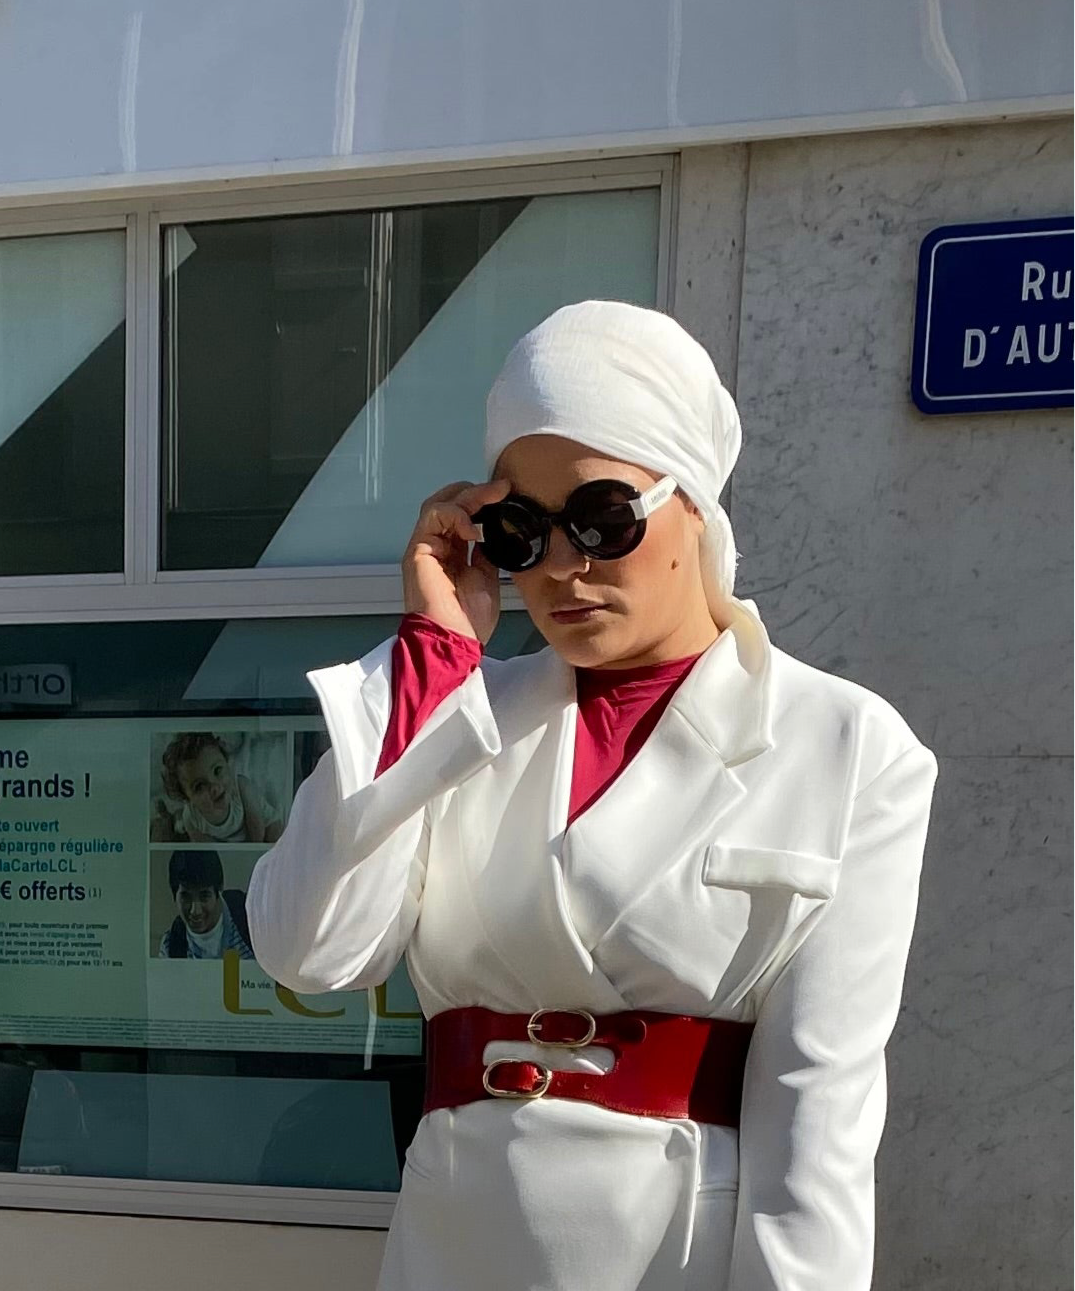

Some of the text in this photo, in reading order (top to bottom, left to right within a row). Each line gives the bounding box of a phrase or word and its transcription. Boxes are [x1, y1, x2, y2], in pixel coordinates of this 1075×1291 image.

[1021, 261, 1072, 301] Ru
[14, 820, 59, 832] ouvert
[60, 838, 124, 855] régulière
[1, 881, 12, 899] €
[18, 881, 86, 900] offerts
